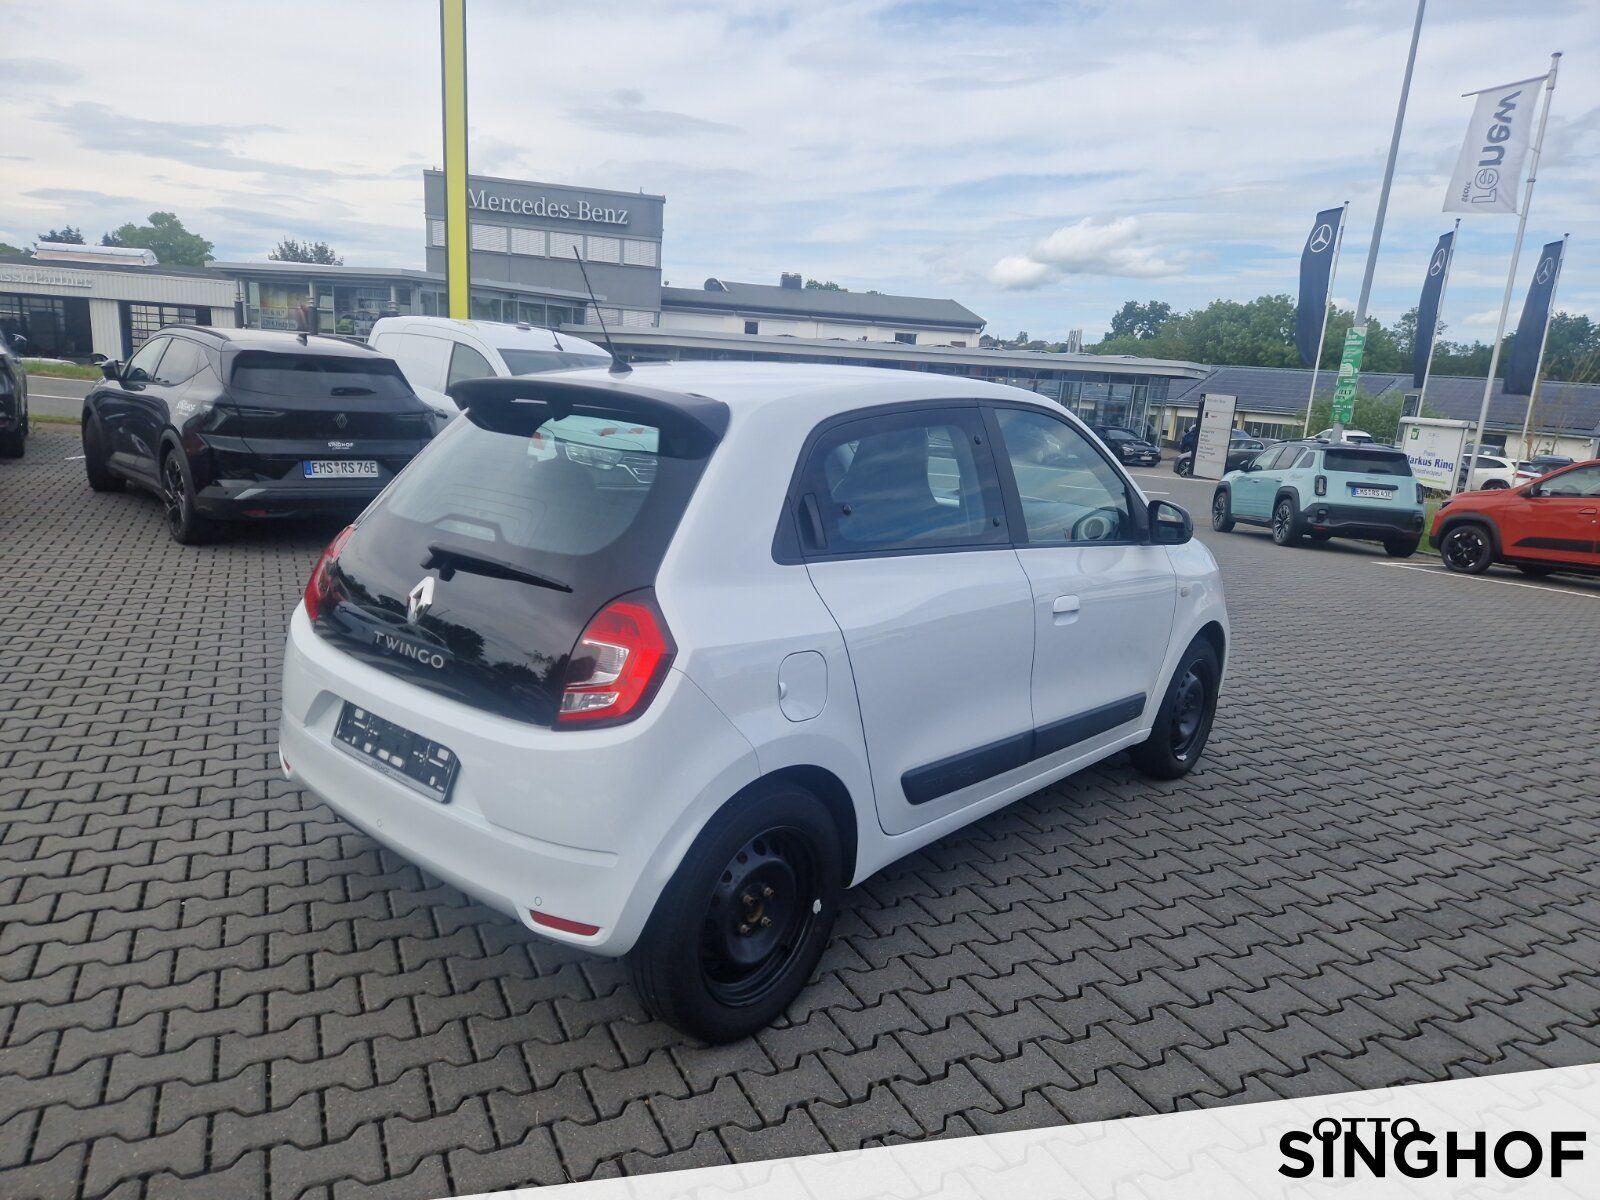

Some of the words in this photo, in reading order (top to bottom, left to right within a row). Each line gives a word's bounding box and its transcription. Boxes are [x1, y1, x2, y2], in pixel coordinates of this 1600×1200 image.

[468, 188, 629, 225] Mercedes-Benz
[34, 271, 92, 287] Partner
[311, 462, 334, 474] EMS
[341, 462, 354, 474] RS
[357, 462, 377, 474] 76E
[1434, 459, 1454, 472] Ring
[374, 630, 444, 669] TWINGO
